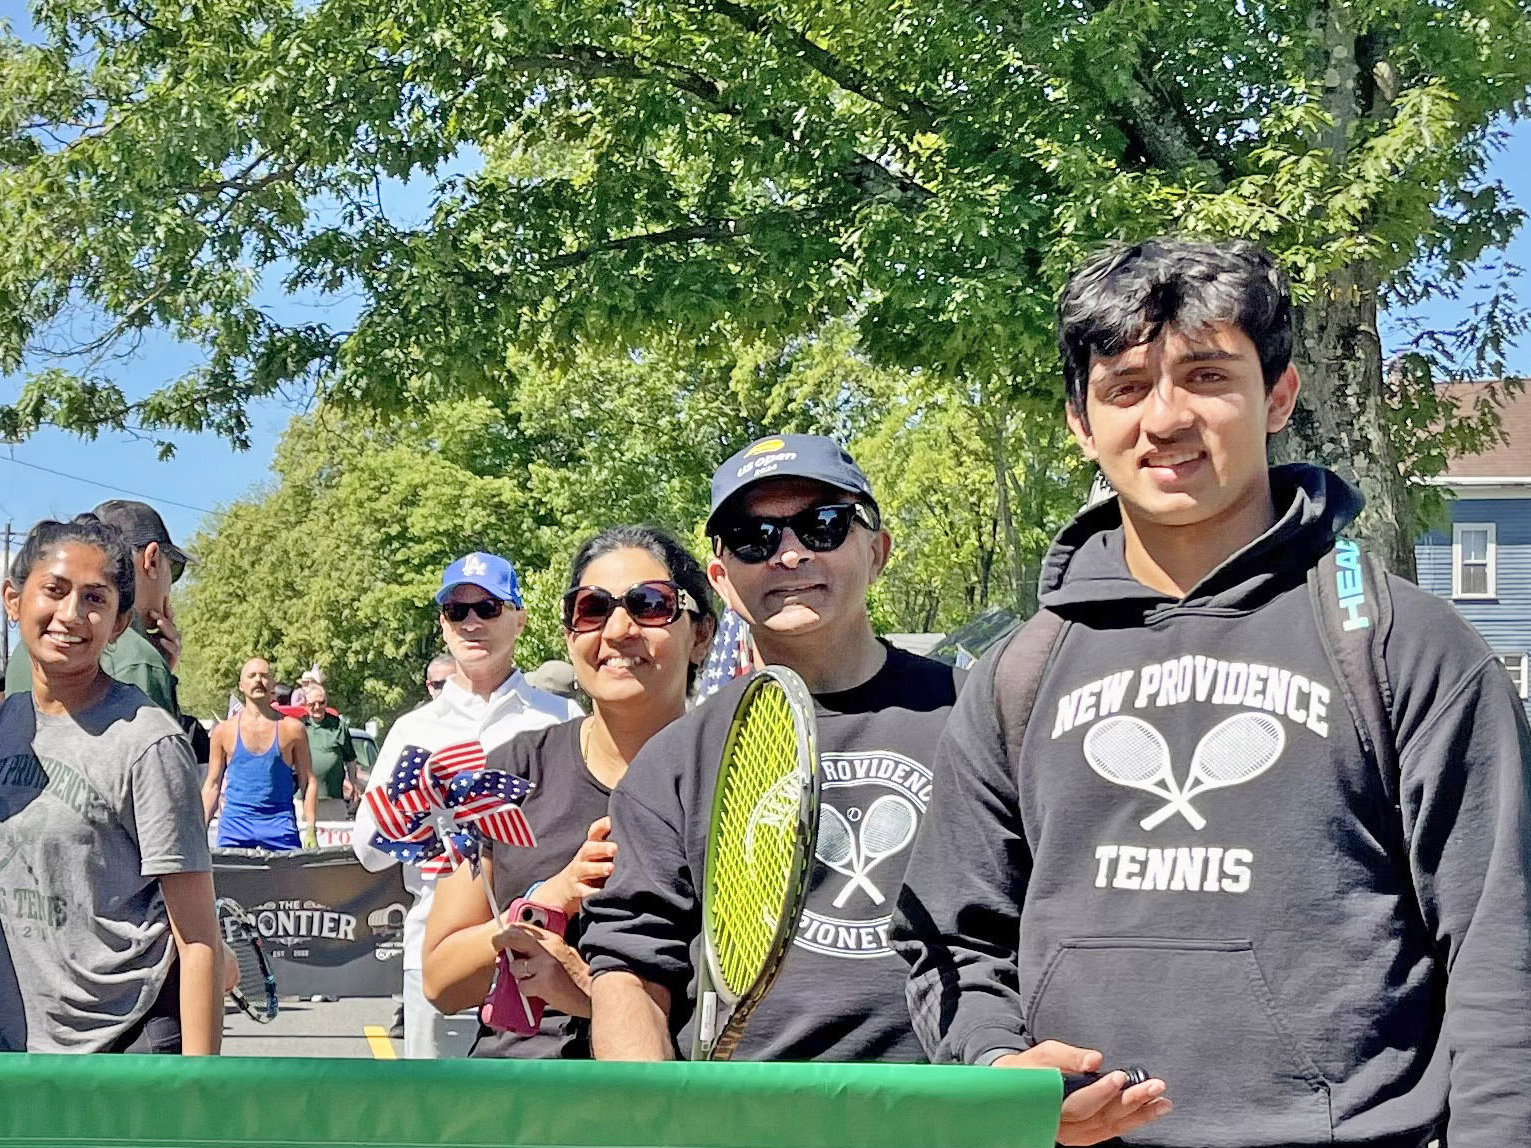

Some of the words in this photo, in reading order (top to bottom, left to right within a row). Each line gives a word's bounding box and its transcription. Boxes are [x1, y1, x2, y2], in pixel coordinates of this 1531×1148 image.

[462, 555, 486, 576] LA
[1051, 670, 1134, 739] NEW
[1134, 655, 1330, 738] PROVIDENCE
[820, 759, 933, 802] ROVIDENC
[1095, 845, 1253, 893] TENNIS
[14, 887, 68, 927] TENIS
[278, 900, 300, 910] THE
